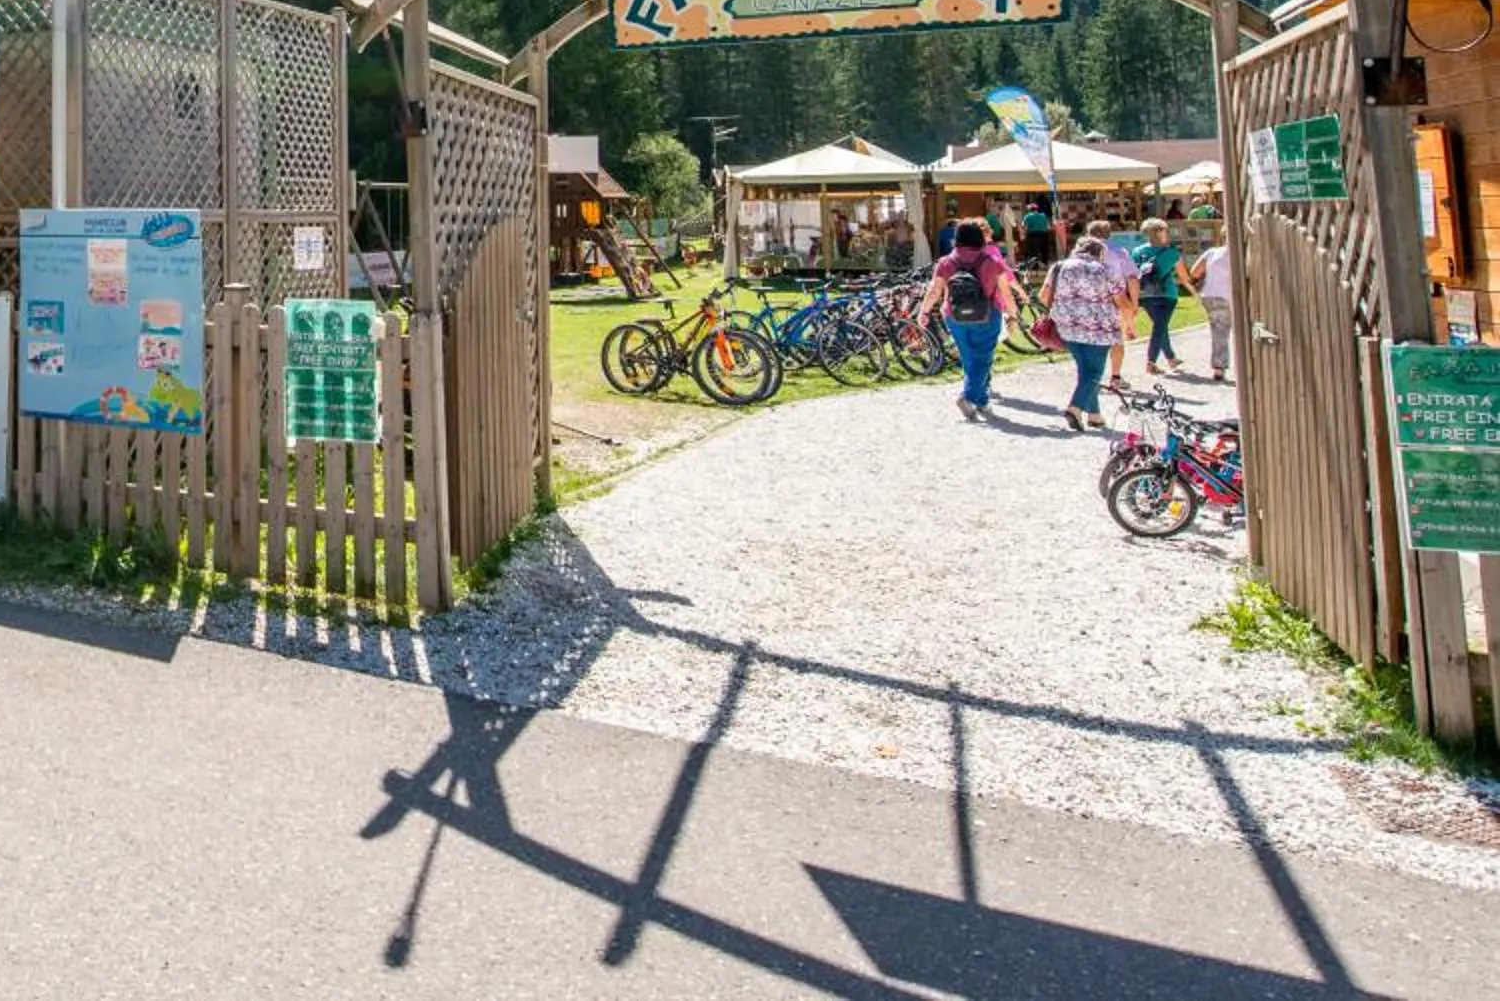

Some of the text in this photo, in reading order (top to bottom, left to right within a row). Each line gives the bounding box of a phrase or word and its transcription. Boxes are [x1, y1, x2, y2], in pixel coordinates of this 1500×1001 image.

[1407, 392, 1493, 408] ENTRATA
[1412, 410, 1456, 425] FREI
[1429, 427, 1477, 442] FREE
